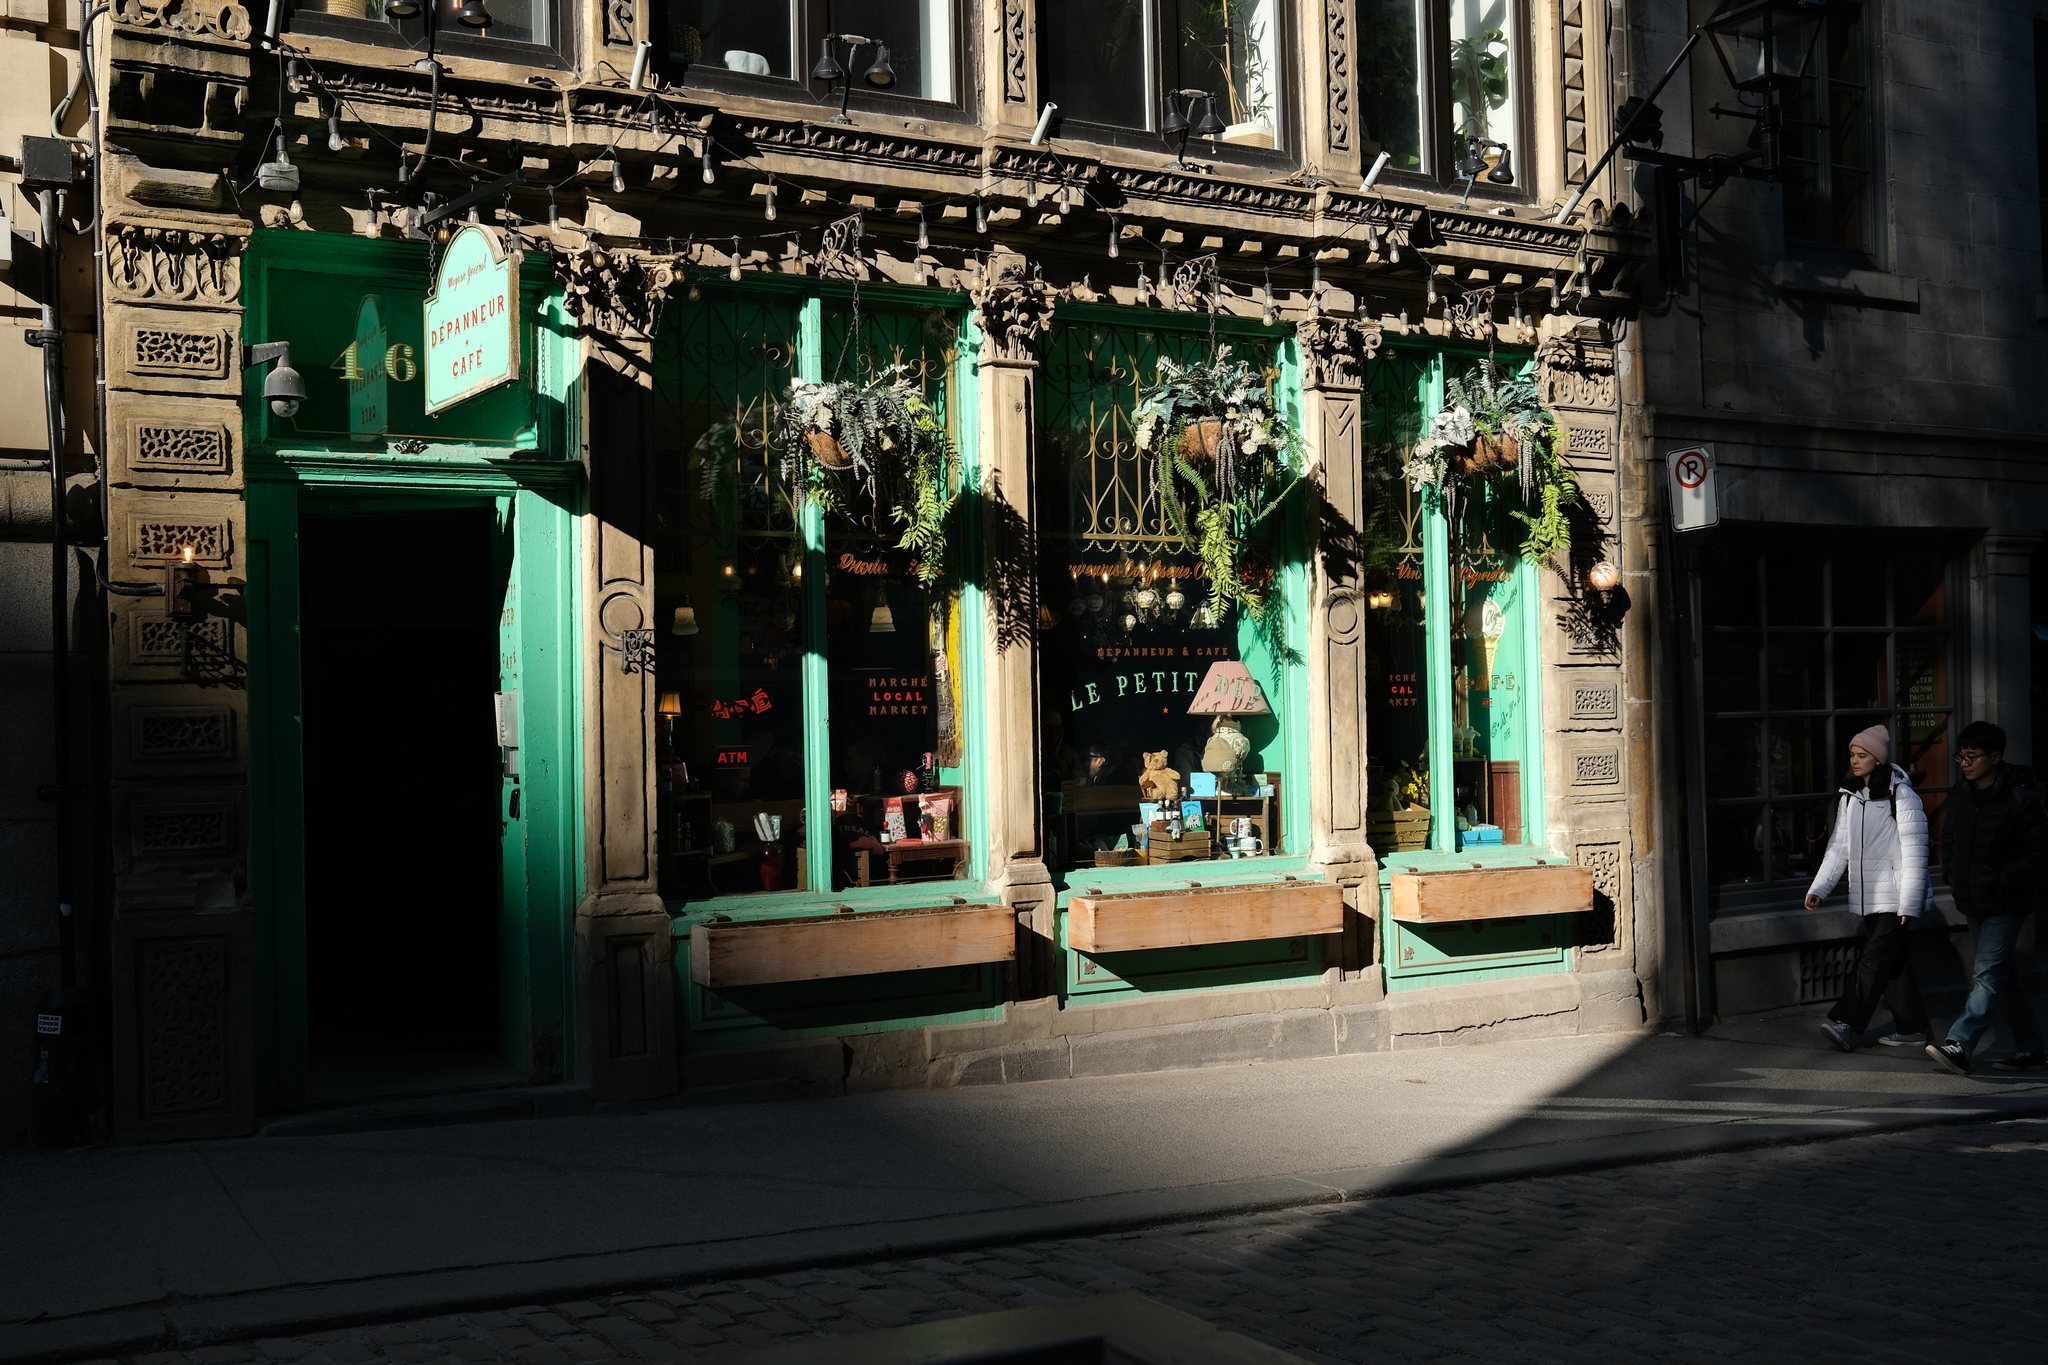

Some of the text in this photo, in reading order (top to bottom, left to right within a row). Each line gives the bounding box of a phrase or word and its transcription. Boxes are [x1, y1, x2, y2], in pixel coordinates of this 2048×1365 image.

[431, 294, 505, 348] DÉPANNEUR
[453, 344, 483, 377] CAFÉ
[1097, 645, 1174, 657] DÉPANNEUR
[1197, 645, 1229, 657] CAFÉ
[868, 674, 929, 687] MARCHÉ
[873, 691, 922, 701] LOCAL
[1071, 682, 1100, 712] LE
[1116, 671, 1199, 697] PETIT
[1215, 674, 1262, 704] DEP
[1391, 686, 1413, 694] CAL
[868, 705, 929, 716] MARKET
[717, 751, 748, 764] ATM
